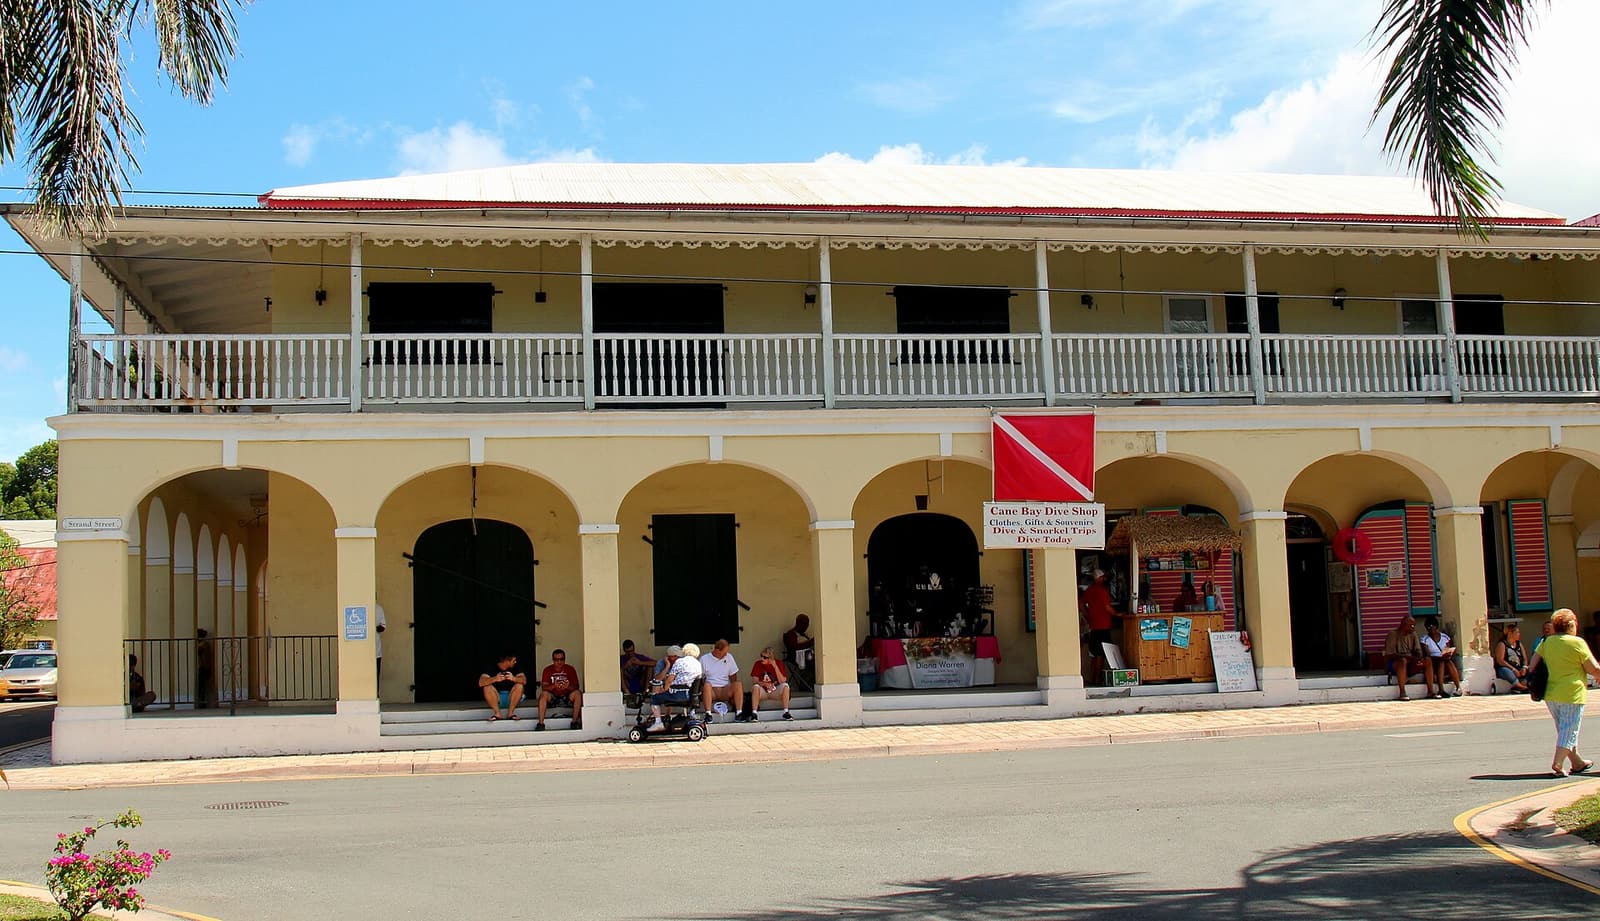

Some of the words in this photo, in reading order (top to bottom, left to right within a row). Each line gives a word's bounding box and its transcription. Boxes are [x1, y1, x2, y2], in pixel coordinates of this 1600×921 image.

[990, 506, 1018, 516] Cane
[1021, 506, 1041, 518] Bay
[1045, 506, 1069, 516] Dive
[1071, 506, 1098, 518] Shop
[68, 520, 91, 528] Strand
[1024, 518, 1044, 526] Gifts
[1055, 518, 1094, 526] Souvenirs
[1018, 527, 1027, 535] &
[1029, 527, 1068, 535] Snorkel
[1070, 527, 1097, 535] Trips
[1043, 536, 1072, 544] Today
[916, 661, 937, 669] Diana
[939, 661, 965, 669] Warren
